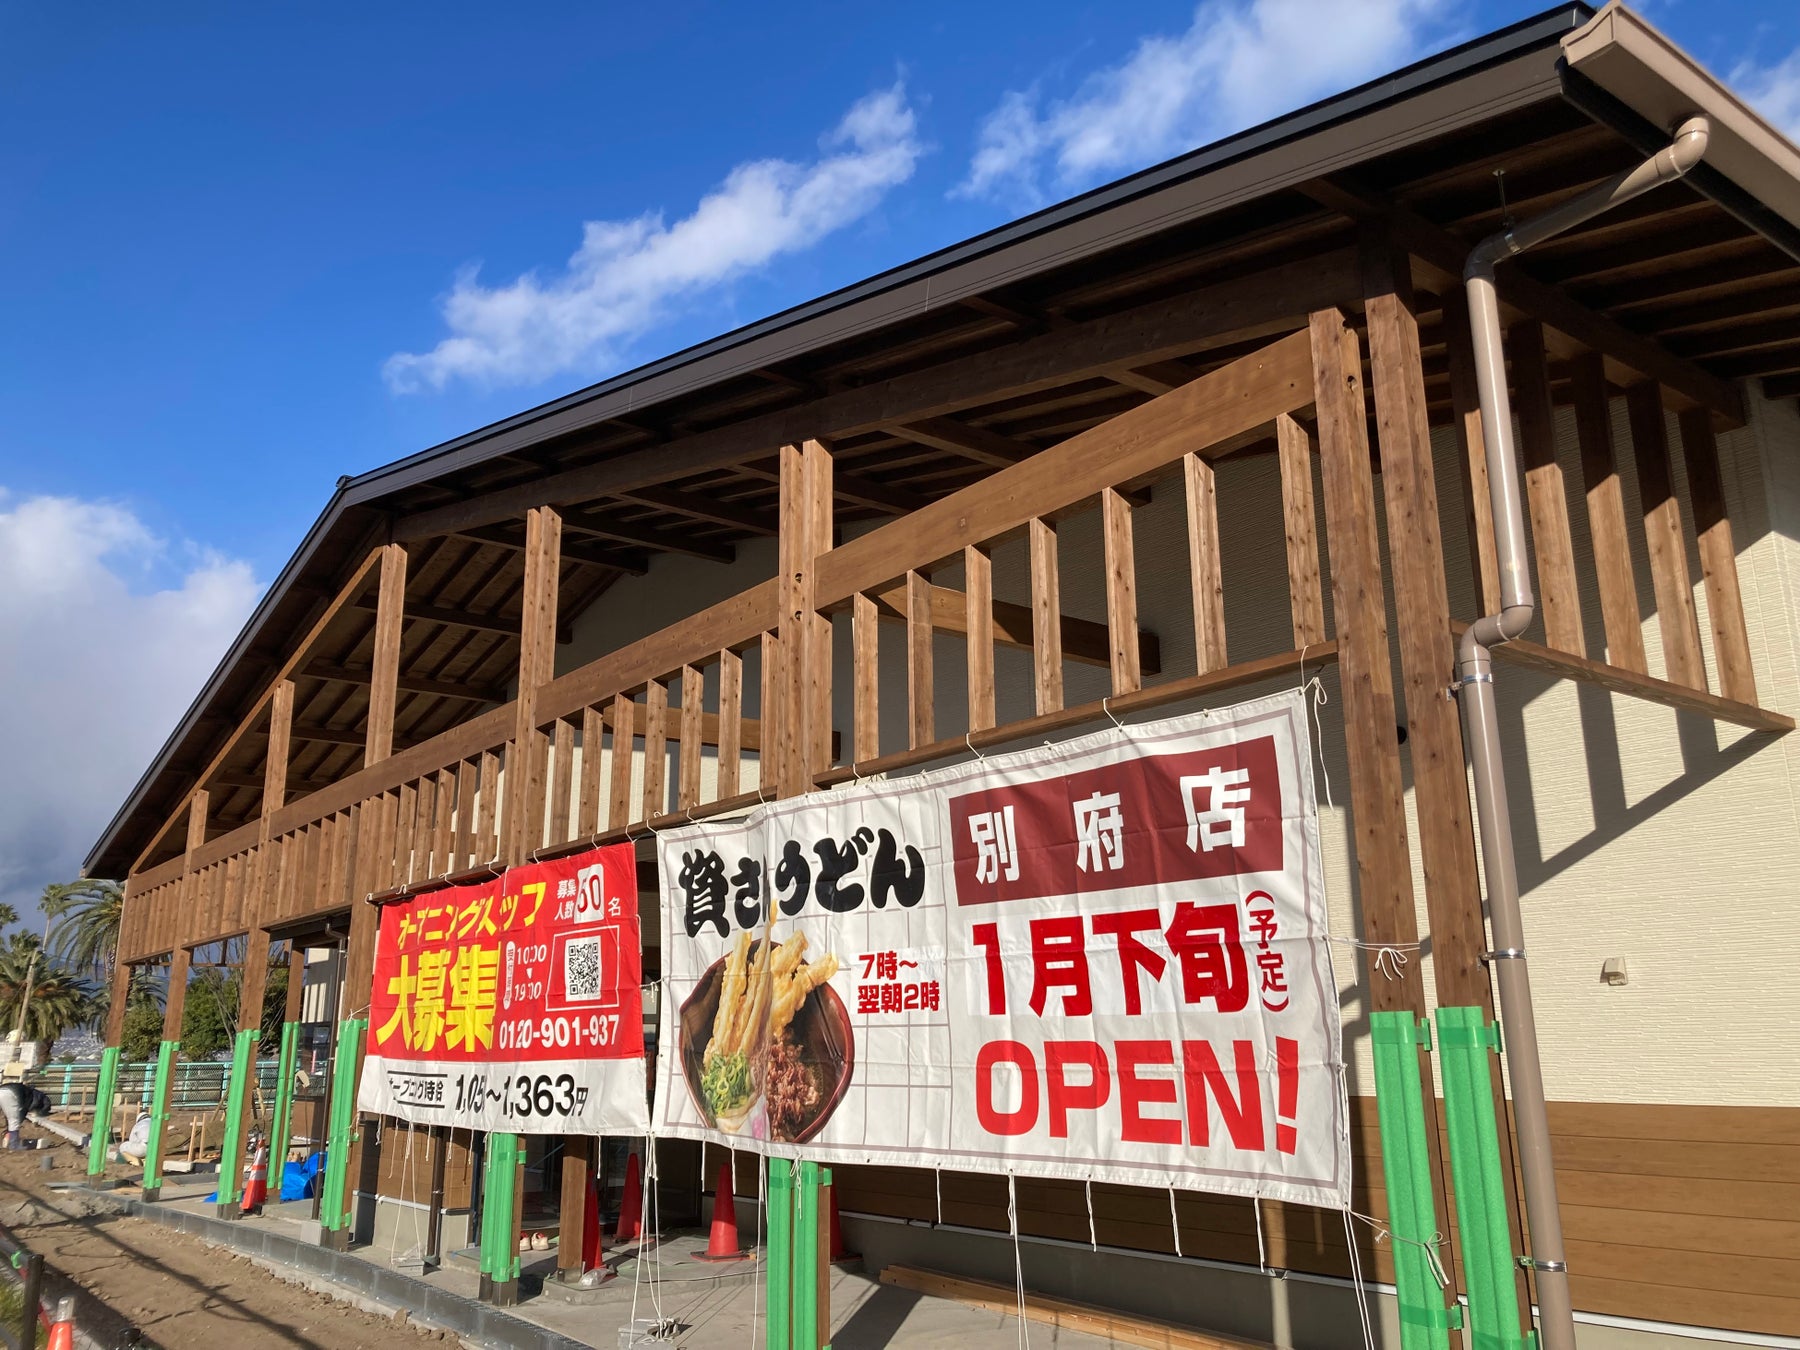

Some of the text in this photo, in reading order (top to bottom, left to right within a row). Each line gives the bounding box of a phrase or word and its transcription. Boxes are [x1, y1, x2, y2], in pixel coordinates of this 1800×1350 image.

[967, 766, 1252, 884] 別府店
[608, 896, 621, 917] 名
[679, 827, 925, 938] 資さうどん
[376, 942, 501, 1053] 大募集
[857, 979, 940, 1014] 翌朝2時
[972, 901, 1250, 1017] 1月下旬
[499, 1014, 620, 1050] 0120-901-937
[975, 1035, 1299, 1156] OPEN!
